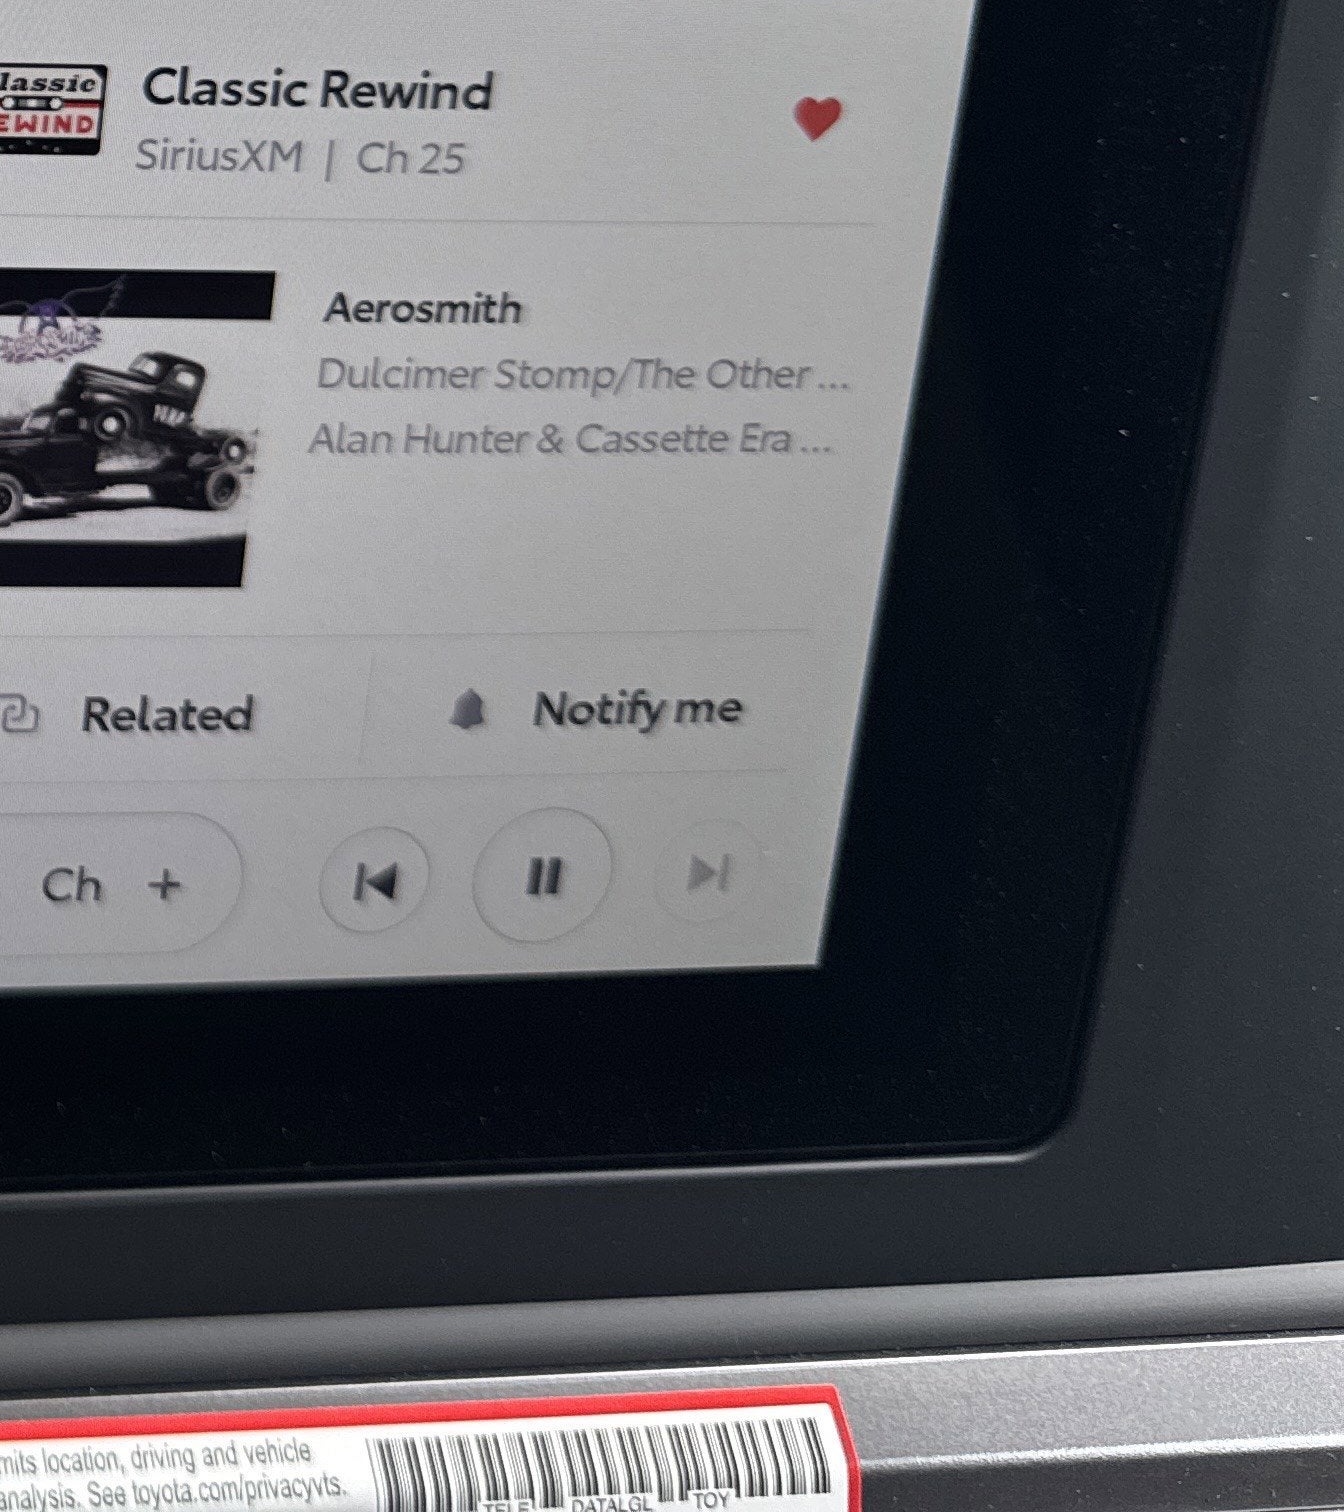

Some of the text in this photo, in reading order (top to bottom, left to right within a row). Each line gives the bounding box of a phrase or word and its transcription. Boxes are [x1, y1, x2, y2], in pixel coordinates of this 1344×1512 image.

[142, 66, 494, 110] Classic Rewind
[134, 137, 303, 173] SiriusXM
[357, 140, 409, 174] Ch
[418, 142, 466, 175] 25
[322, 291, 523, 324] Aerosmith
[317, 357, 487, 389] Dulcimer
[494, 357, 696, 397] Stomp/The
[707, 357, 812, 389] Other
[308, 423, 393, 454] Alan
[403, 423, 527, 455] Hunter
[537, 423, 564, 454] &
[576, 423, 730, 455] Cassette
[740, 423, 792, 454] Era
[81, 694, 254, 732] Related
[533, 689, 744, 734] Notify me
[42, 866, 103, 902] Ch
[42, 1444, 126, 1476] location,
[131, 1442, 196, 1474] driving
[202, 1439, 237, 1467] and
[243, 1436, 311, 1464] vehicle
[87, 1479, 127, 1508] See
[692, 1490, 731, 1510] TOY
